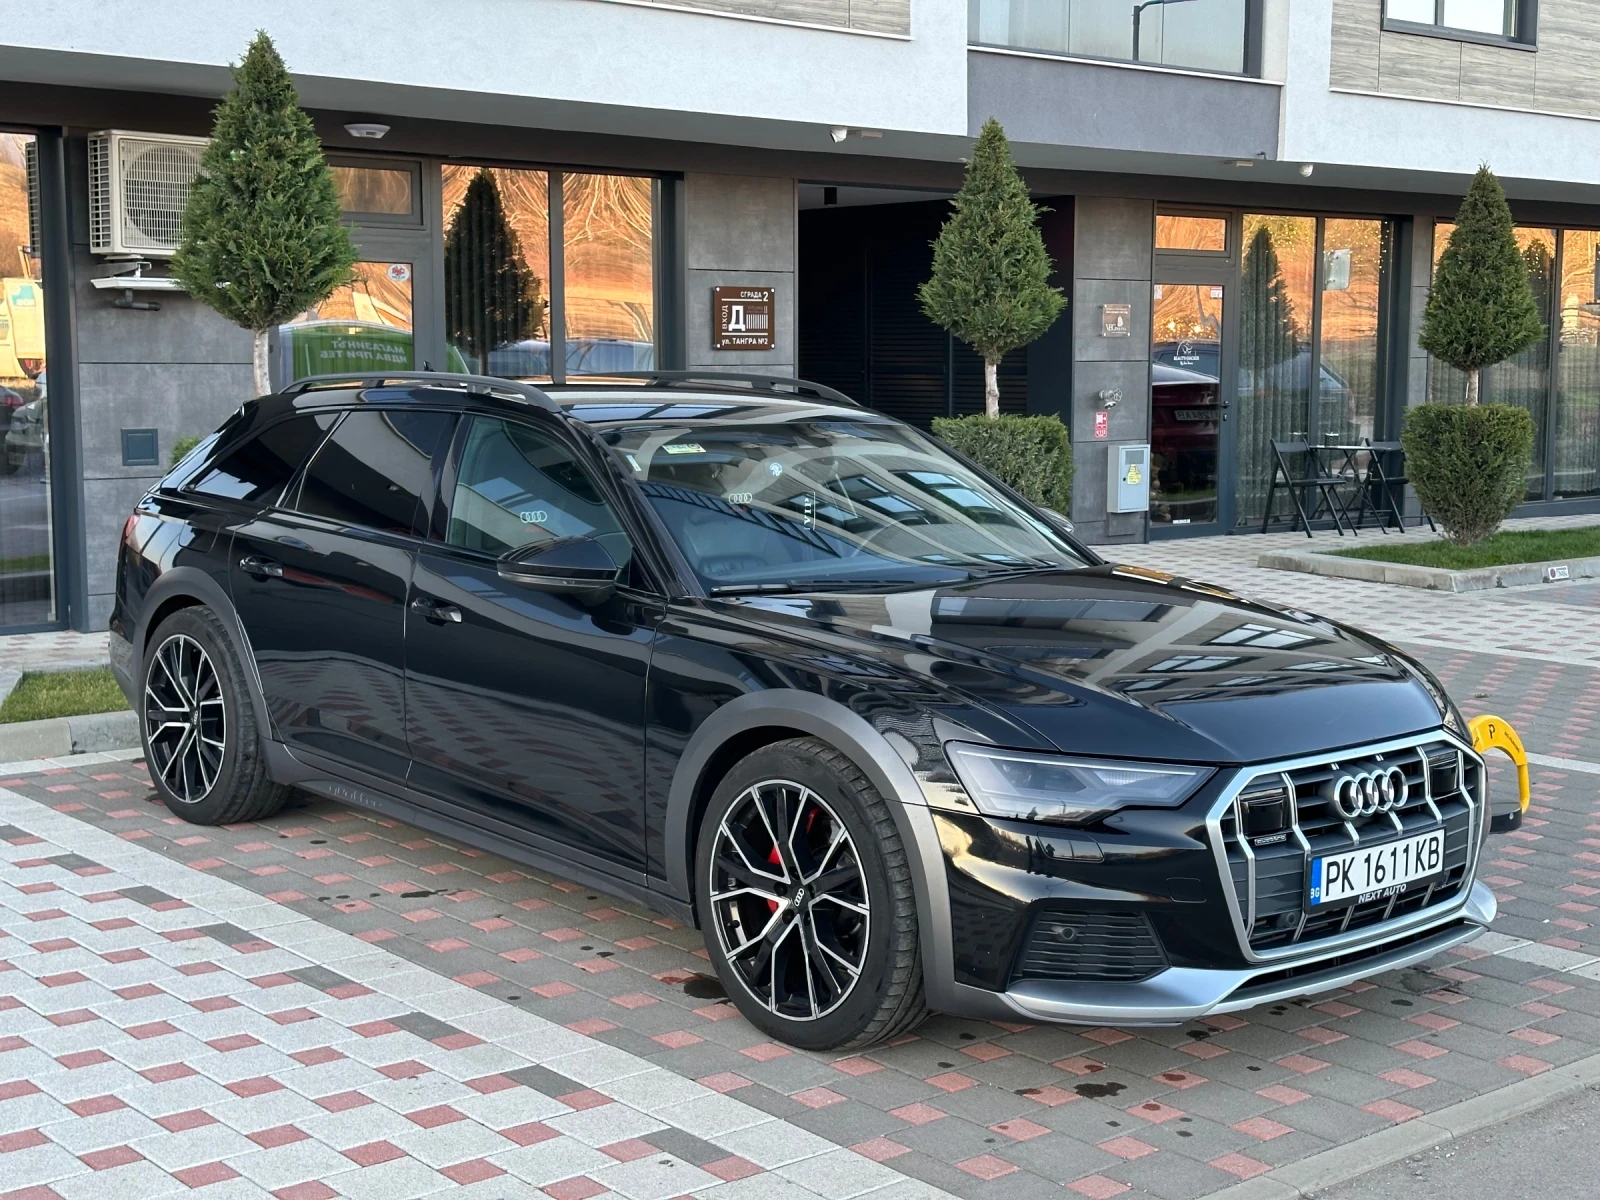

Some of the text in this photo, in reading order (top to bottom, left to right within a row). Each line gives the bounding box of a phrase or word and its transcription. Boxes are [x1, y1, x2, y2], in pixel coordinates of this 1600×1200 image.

[740, 291, 768, 301] СГРАДА 2
[728, 305, 745, 331] Д
[721, 338, 731, 346] ул.
[1488, 724, 1495, 739] P
[1325, 857, 1356, 897] PK
[1358, 884, 1407, 904] NEXT AUTO
